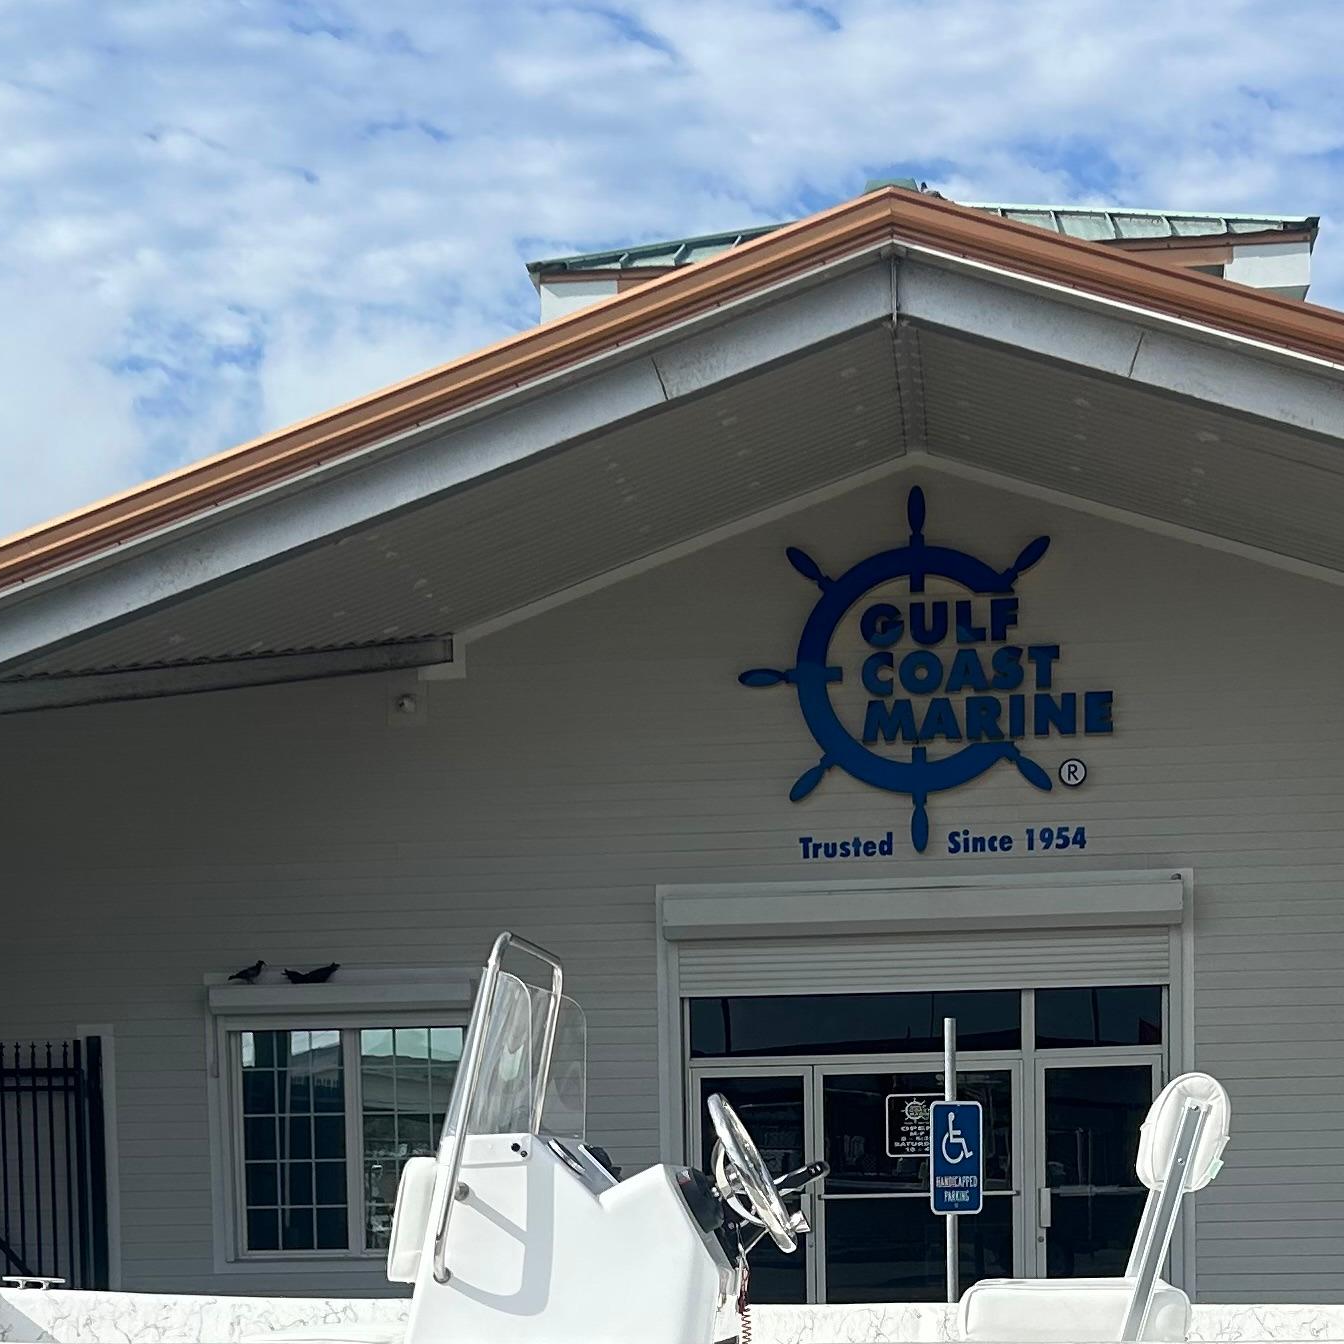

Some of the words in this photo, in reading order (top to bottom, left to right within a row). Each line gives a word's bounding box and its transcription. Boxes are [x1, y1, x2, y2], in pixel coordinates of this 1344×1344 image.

[860, 597, 1019, 647] GULF
[861, 644, 1061, 696] COAST
[862, 690, 1114, 746] MARINE
[799, 832, 894, 860] Trusted
[948, 831, 1013, 854] Since
[1026, 826, 1087, 851] 1954
[935, 1175, 978, 1188] HANDICAPPED
[944, 1190, 970, 1203] PARKING
